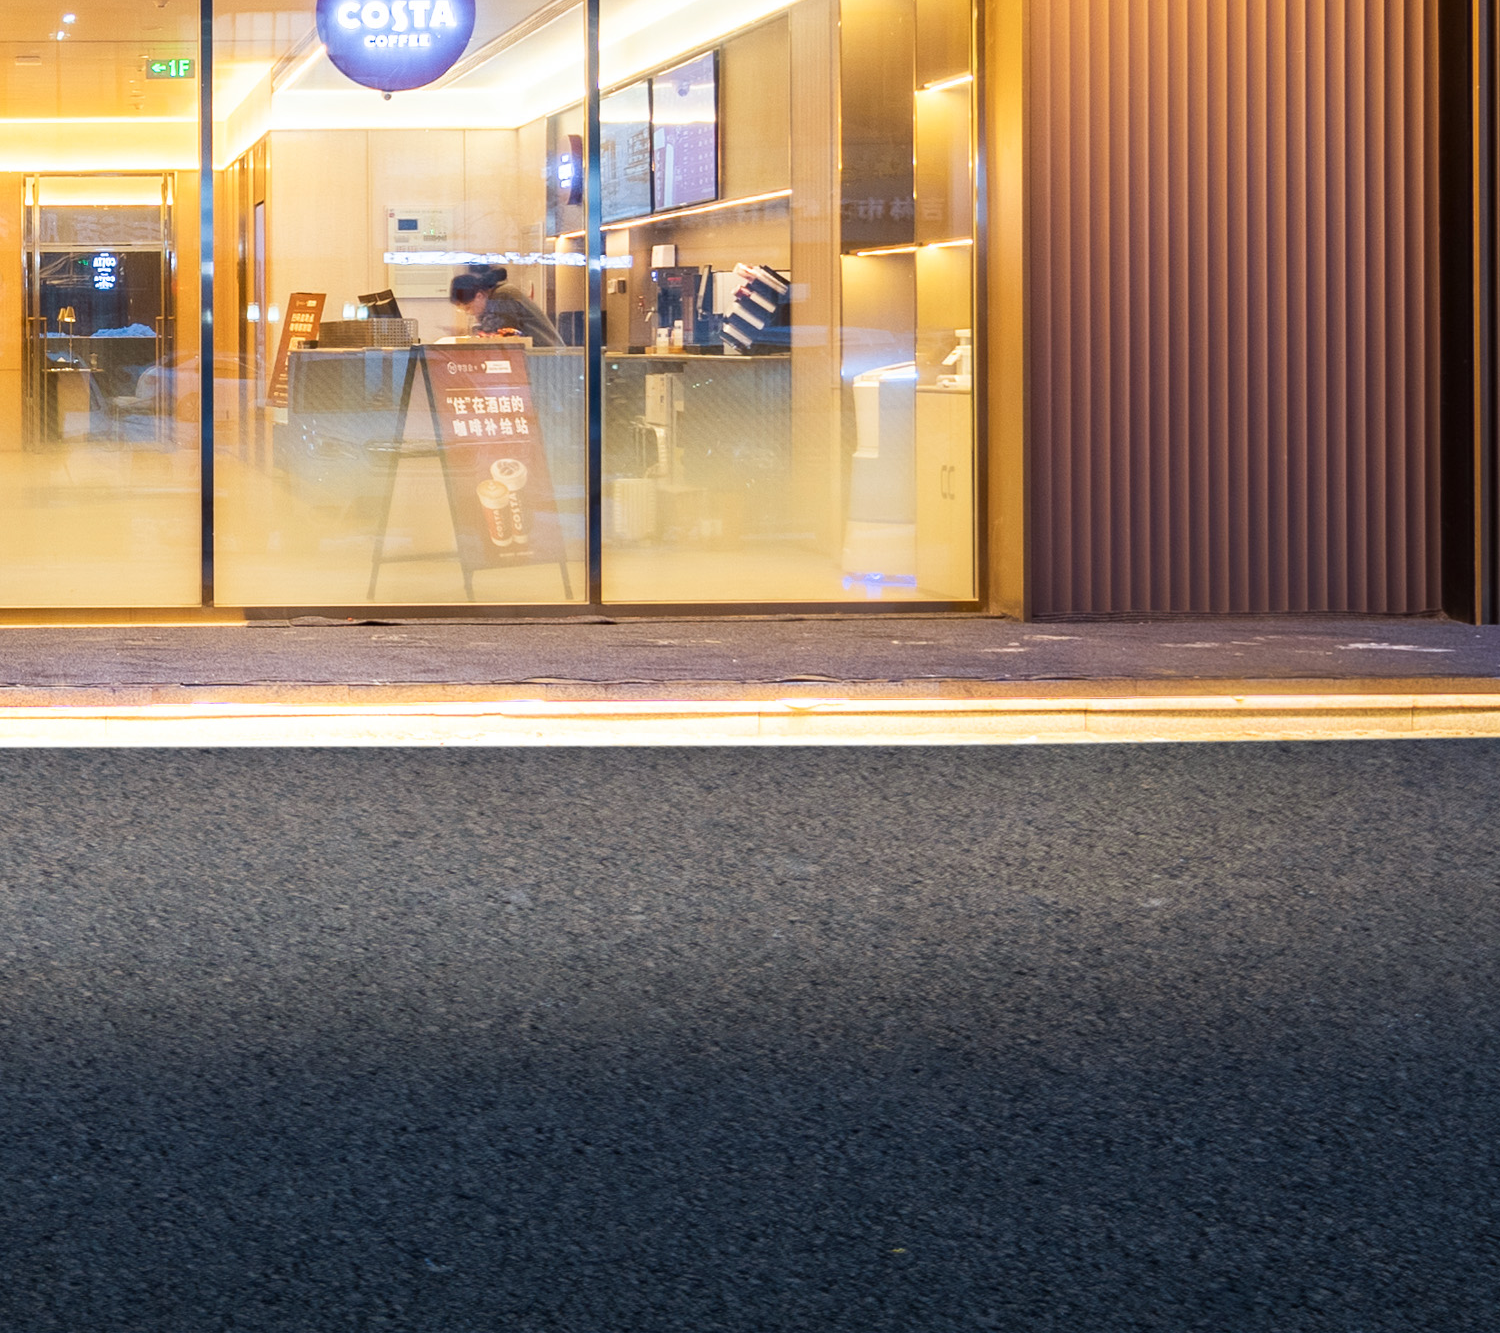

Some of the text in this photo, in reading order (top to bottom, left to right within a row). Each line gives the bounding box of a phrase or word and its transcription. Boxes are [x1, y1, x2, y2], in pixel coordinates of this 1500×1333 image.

[337, 0, 458, 32] COSTA
[364, 35, 431, 48] COFFEE
[168, 59, 191, 77] 1F
[453, 417, 529, 436] 咖啡补给站
